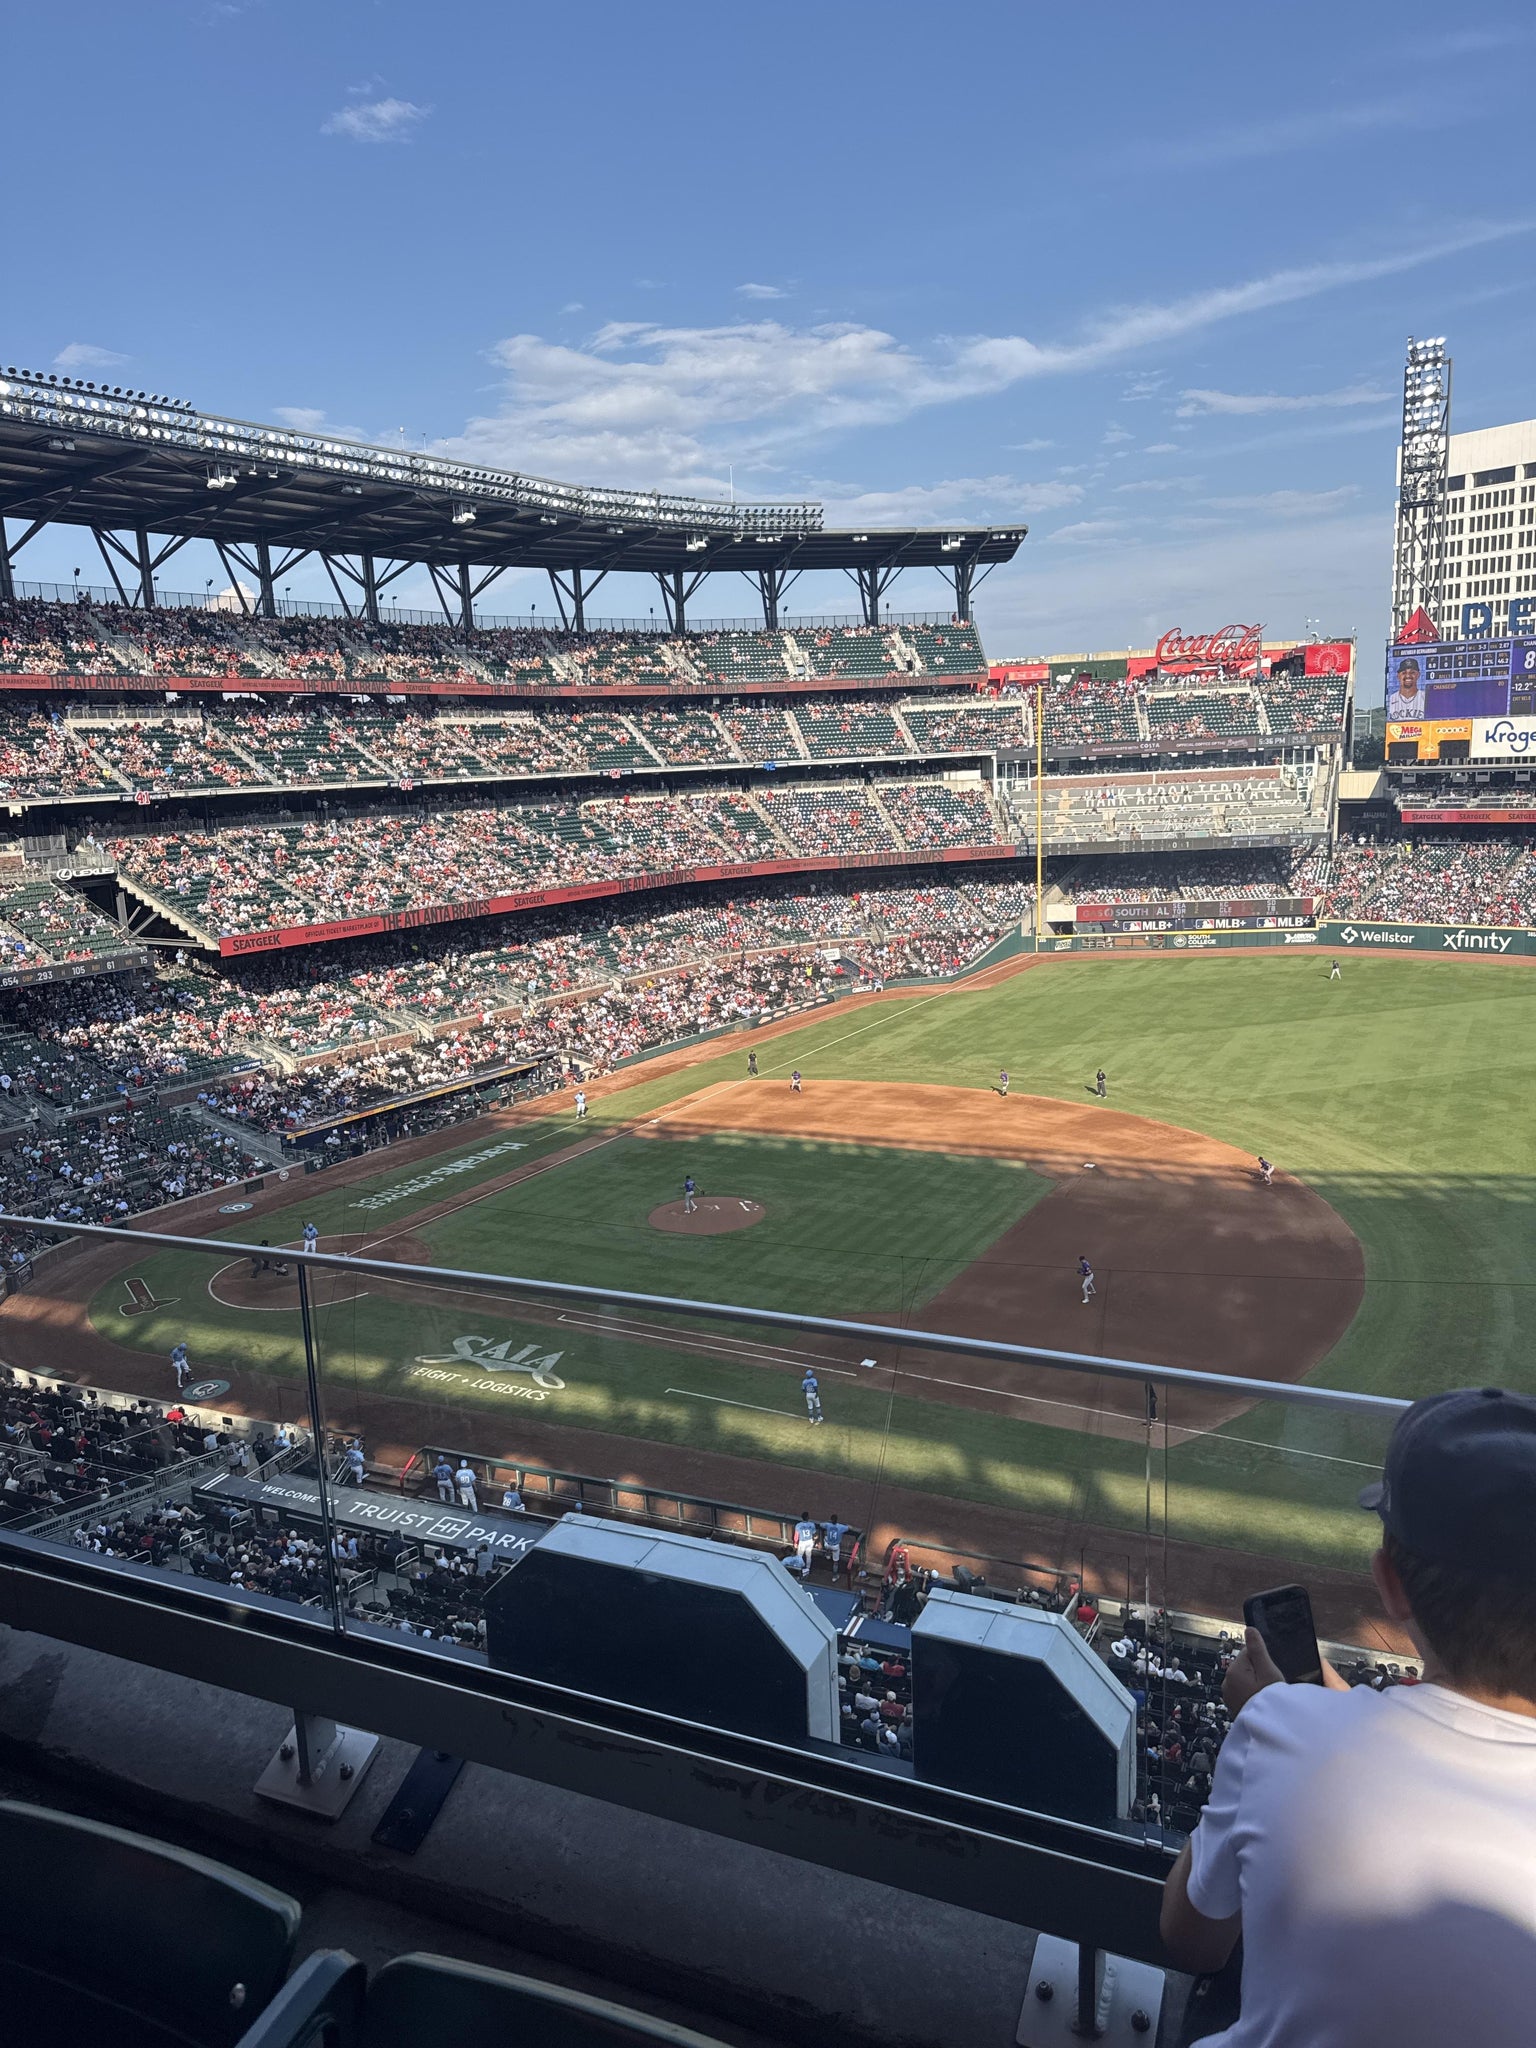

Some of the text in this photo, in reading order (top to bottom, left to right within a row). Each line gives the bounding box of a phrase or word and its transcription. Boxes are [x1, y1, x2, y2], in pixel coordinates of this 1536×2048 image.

[1156, 624, 1267, 664] Coca-Cola
[50, 676, 71, 689] THE
[74, 676, 125, 690] ATLANTA
[127, 677, 170, 690] BRAVES
[190, 680, 224, 688] SEATGEEK
[303, 680, 318, 692] THE
[320, 680, 358, 692] ATLANTA
[360, 681, 392, 693] BRAVES
[856, 679, 869, 688] THE
[870, 678, 908, 687] ATLANTA
[909, 676, 940, 686] BRAVES
[492, 685, 503, 696] THE
[504, 685, 532, 696] ATLANTA
[534, 686, 561, 696] BRAVES
[668, 685, 681, 695] THE
[682, 684, 714, 694] ATLANTA
[716, 684, 746, 694] BRAVES
[1485, 721, 1536, 752] Kroge
[134, 791, 150, 804] 41
[1085, 781, 1281, 808] HANK AARON TERRACE
[970, 848, 1006, 858] SEATGEEK
[720, 866, 752, 876] SEATGEEK
[837, 855, 856, 868] THE
[858, 853, 901, 867] ATLANTA
[905, 851, 944, 864] BRAVES
[72, 867, 114, 877] LEXUS
[514, 894, 545, 908] SEATGEEK
[618, 879, 632, 893] THE
[633, 873, 664, 890] ATLANTA
[665, 869, 696, 886] BRAVES
[1115, 908, 1148, 917] SOUTH
[1156, 907, 1169, 916] AL
[233, 934, 281, 952] SEATGEEK
[342, 923, 373, 932] MARKETPLACE
[380, 913, 402, 931] THE
[404, 906, 450, 928] ATLANTA
[452, 900, 490, 920] BRAVES
[1143, 921, 1173, 930] MLB+
[1216, 919, 1247, 929] MLB+
[1361, 931, 1415, 944] Wellstar
[1443, 930, 1512, 952] xfinity
[0, 977, 19, 987] .654
[36, 971, 53, 981] .293
[72, 965, 85, 975] 105
[106, 961, 115, 969] 61
[140, 956, 148, 964] 15
[349, 1175, 431, 1208] CASINOS
[362, 1177, 444, 1210] CHEROKEE
[425, 1336, 566, 1384] SAIA
[399, 1364, 550, 1401] FREIGHT LOGISTICS
[261, 1485, 320, 1503] WELCOME
[349, 1501, 434, 1528] TRUIST
[465, 1527, 535, 1551] PARK
[802, 1529, 811, 1537] 13
[830, 1531, 837, 1540] 14
